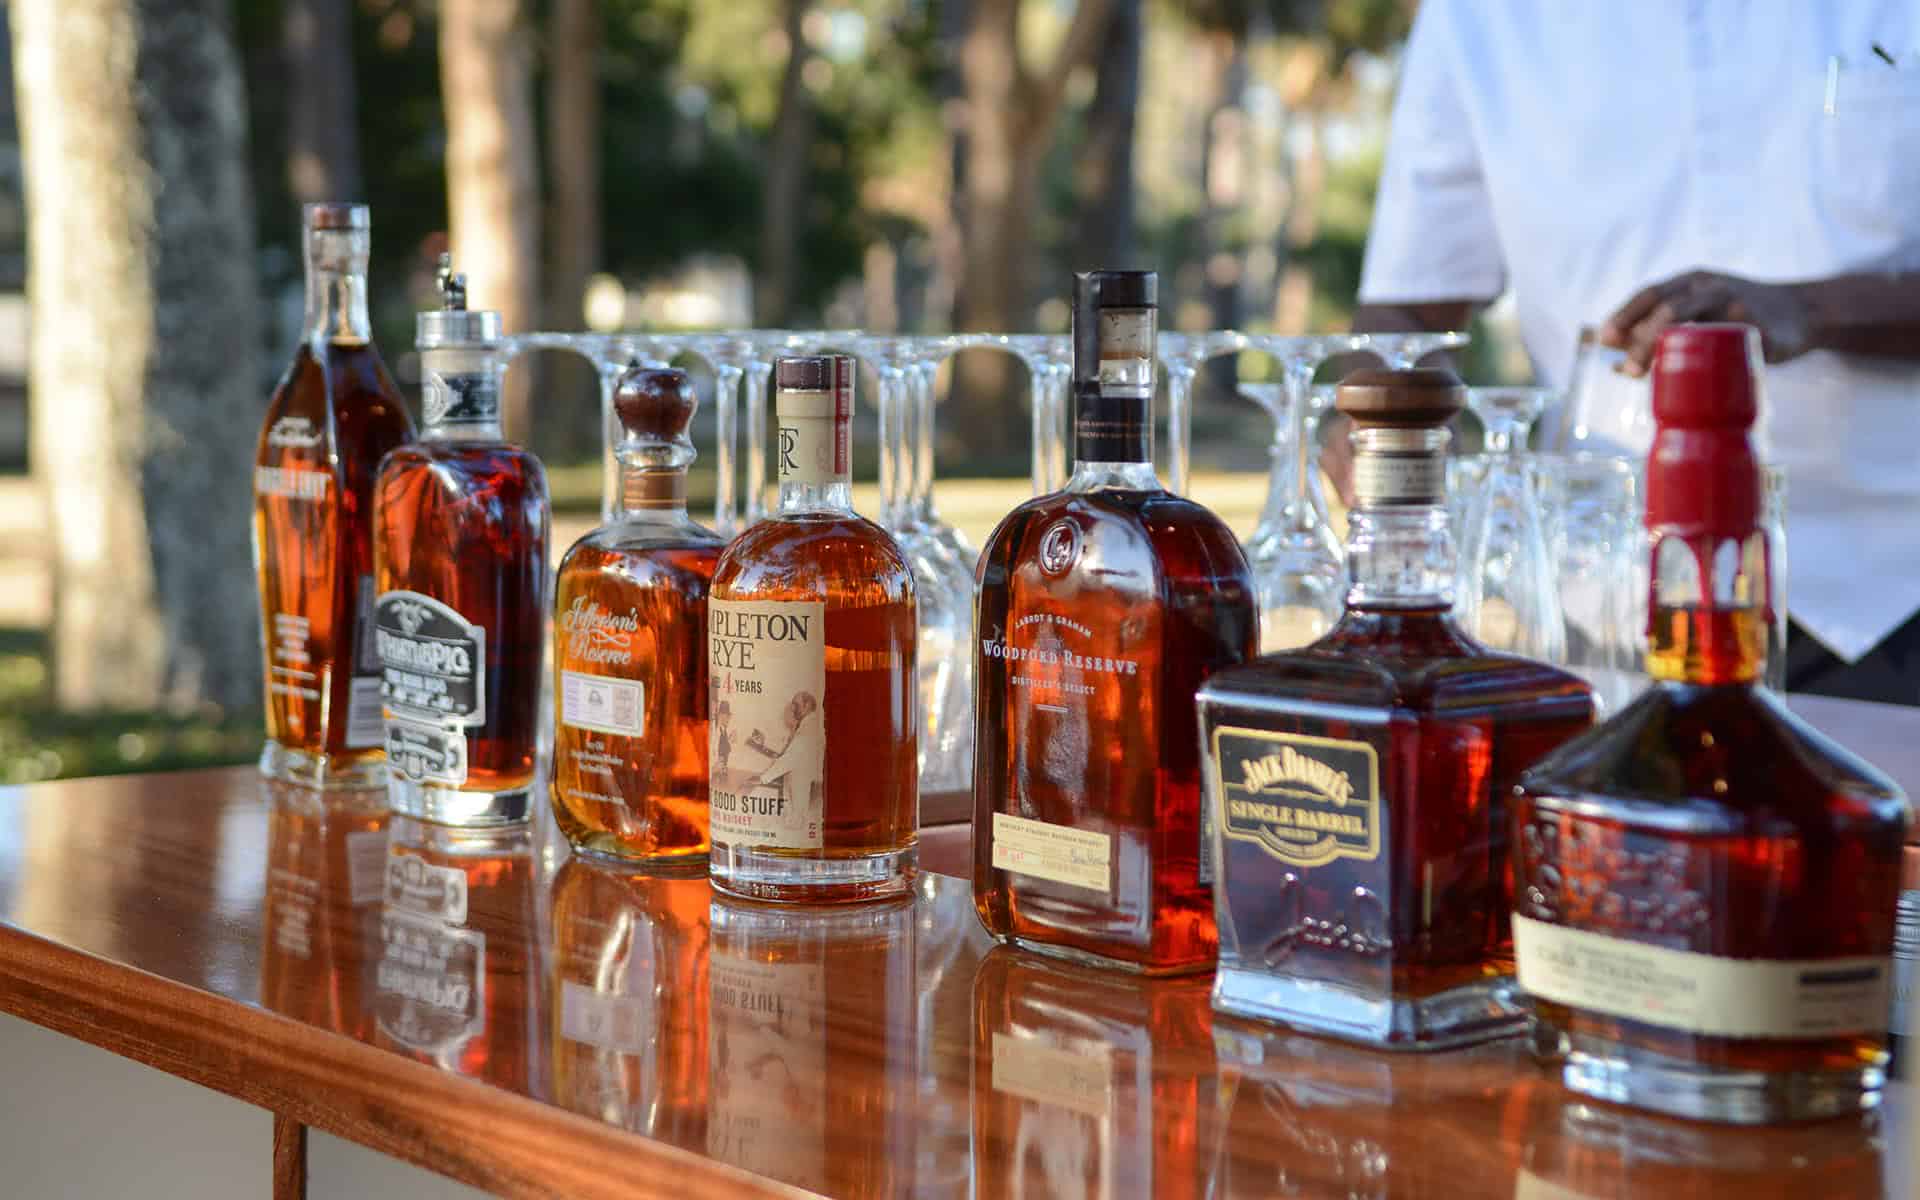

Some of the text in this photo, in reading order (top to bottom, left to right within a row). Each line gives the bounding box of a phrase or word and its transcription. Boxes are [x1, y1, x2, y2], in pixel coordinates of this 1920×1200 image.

[1055, 615, 1094, 639] GRAHAM
[712, 638, 755, 670] RYE
[1063, 649, 1138, 675] RESERVE
[722, 672, 734, 694] 4
[735, 679, 763, 694] YEARS
[741, 795, 786, 816] STUFF
[1229, 799, 1294, 826] SINGLE
[1295, 807, 1364, 834] BARREL
